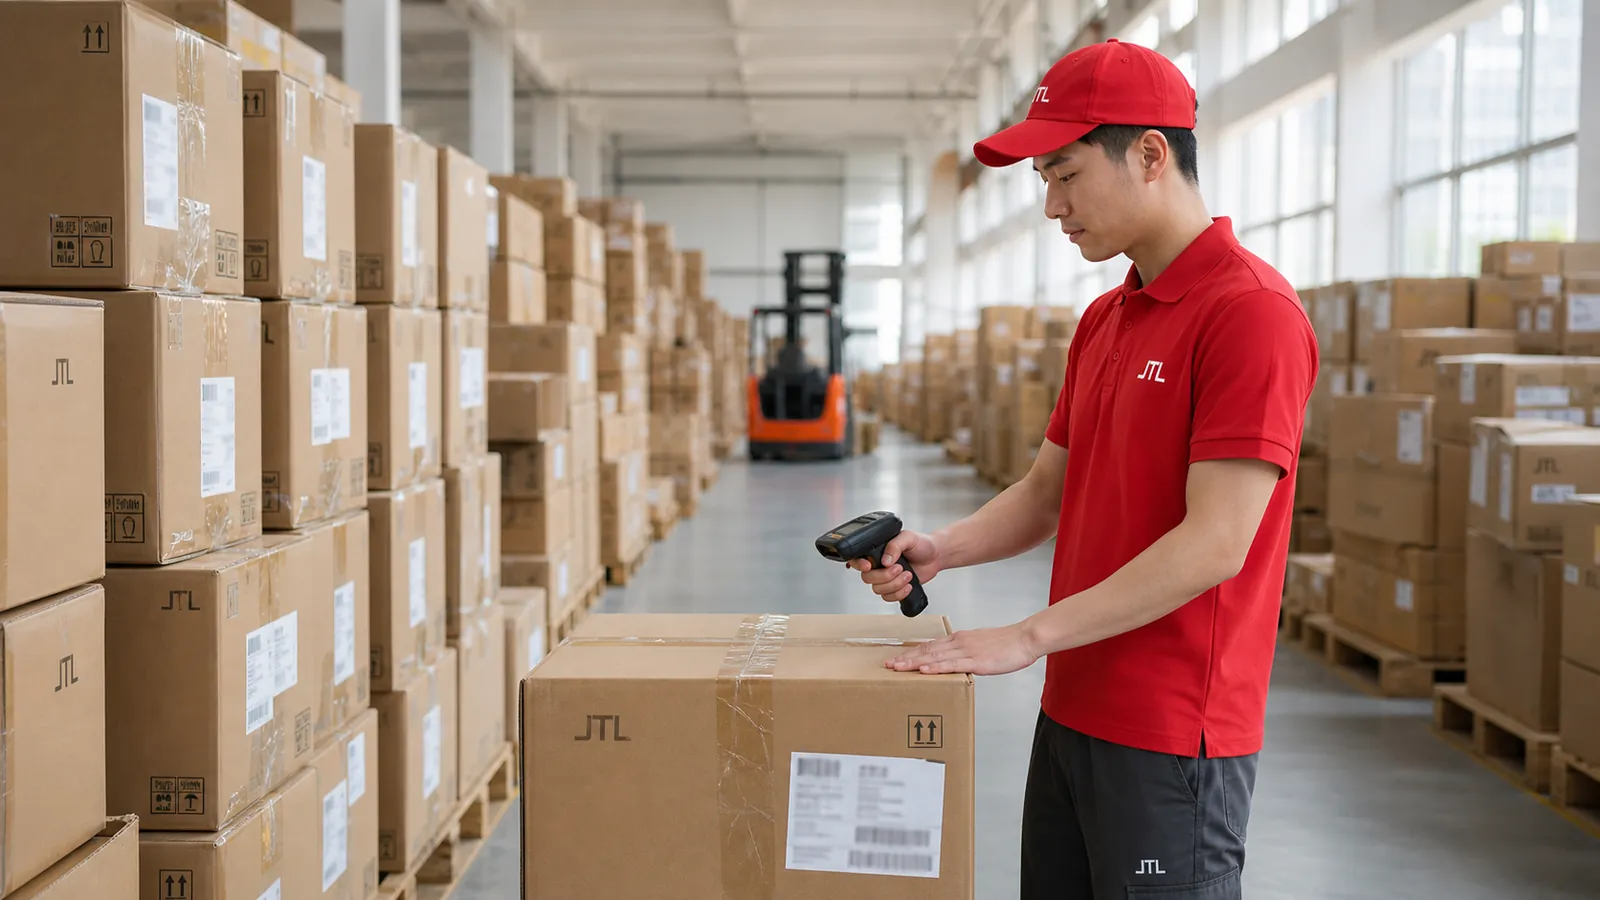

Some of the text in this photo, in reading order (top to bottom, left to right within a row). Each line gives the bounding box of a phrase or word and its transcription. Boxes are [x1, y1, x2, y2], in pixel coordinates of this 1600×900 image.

[52, 358, 74, 385] JTL
[1137, 360, 1166, 383] JTL
[1533, 457, 1560, 475] JTL
[161, 590, 200, 611] JTL
[55, 653, 78, 693] JTL
[574, 715, 631, 741] JTL
[1135, 859, 1166, 875] JTL
